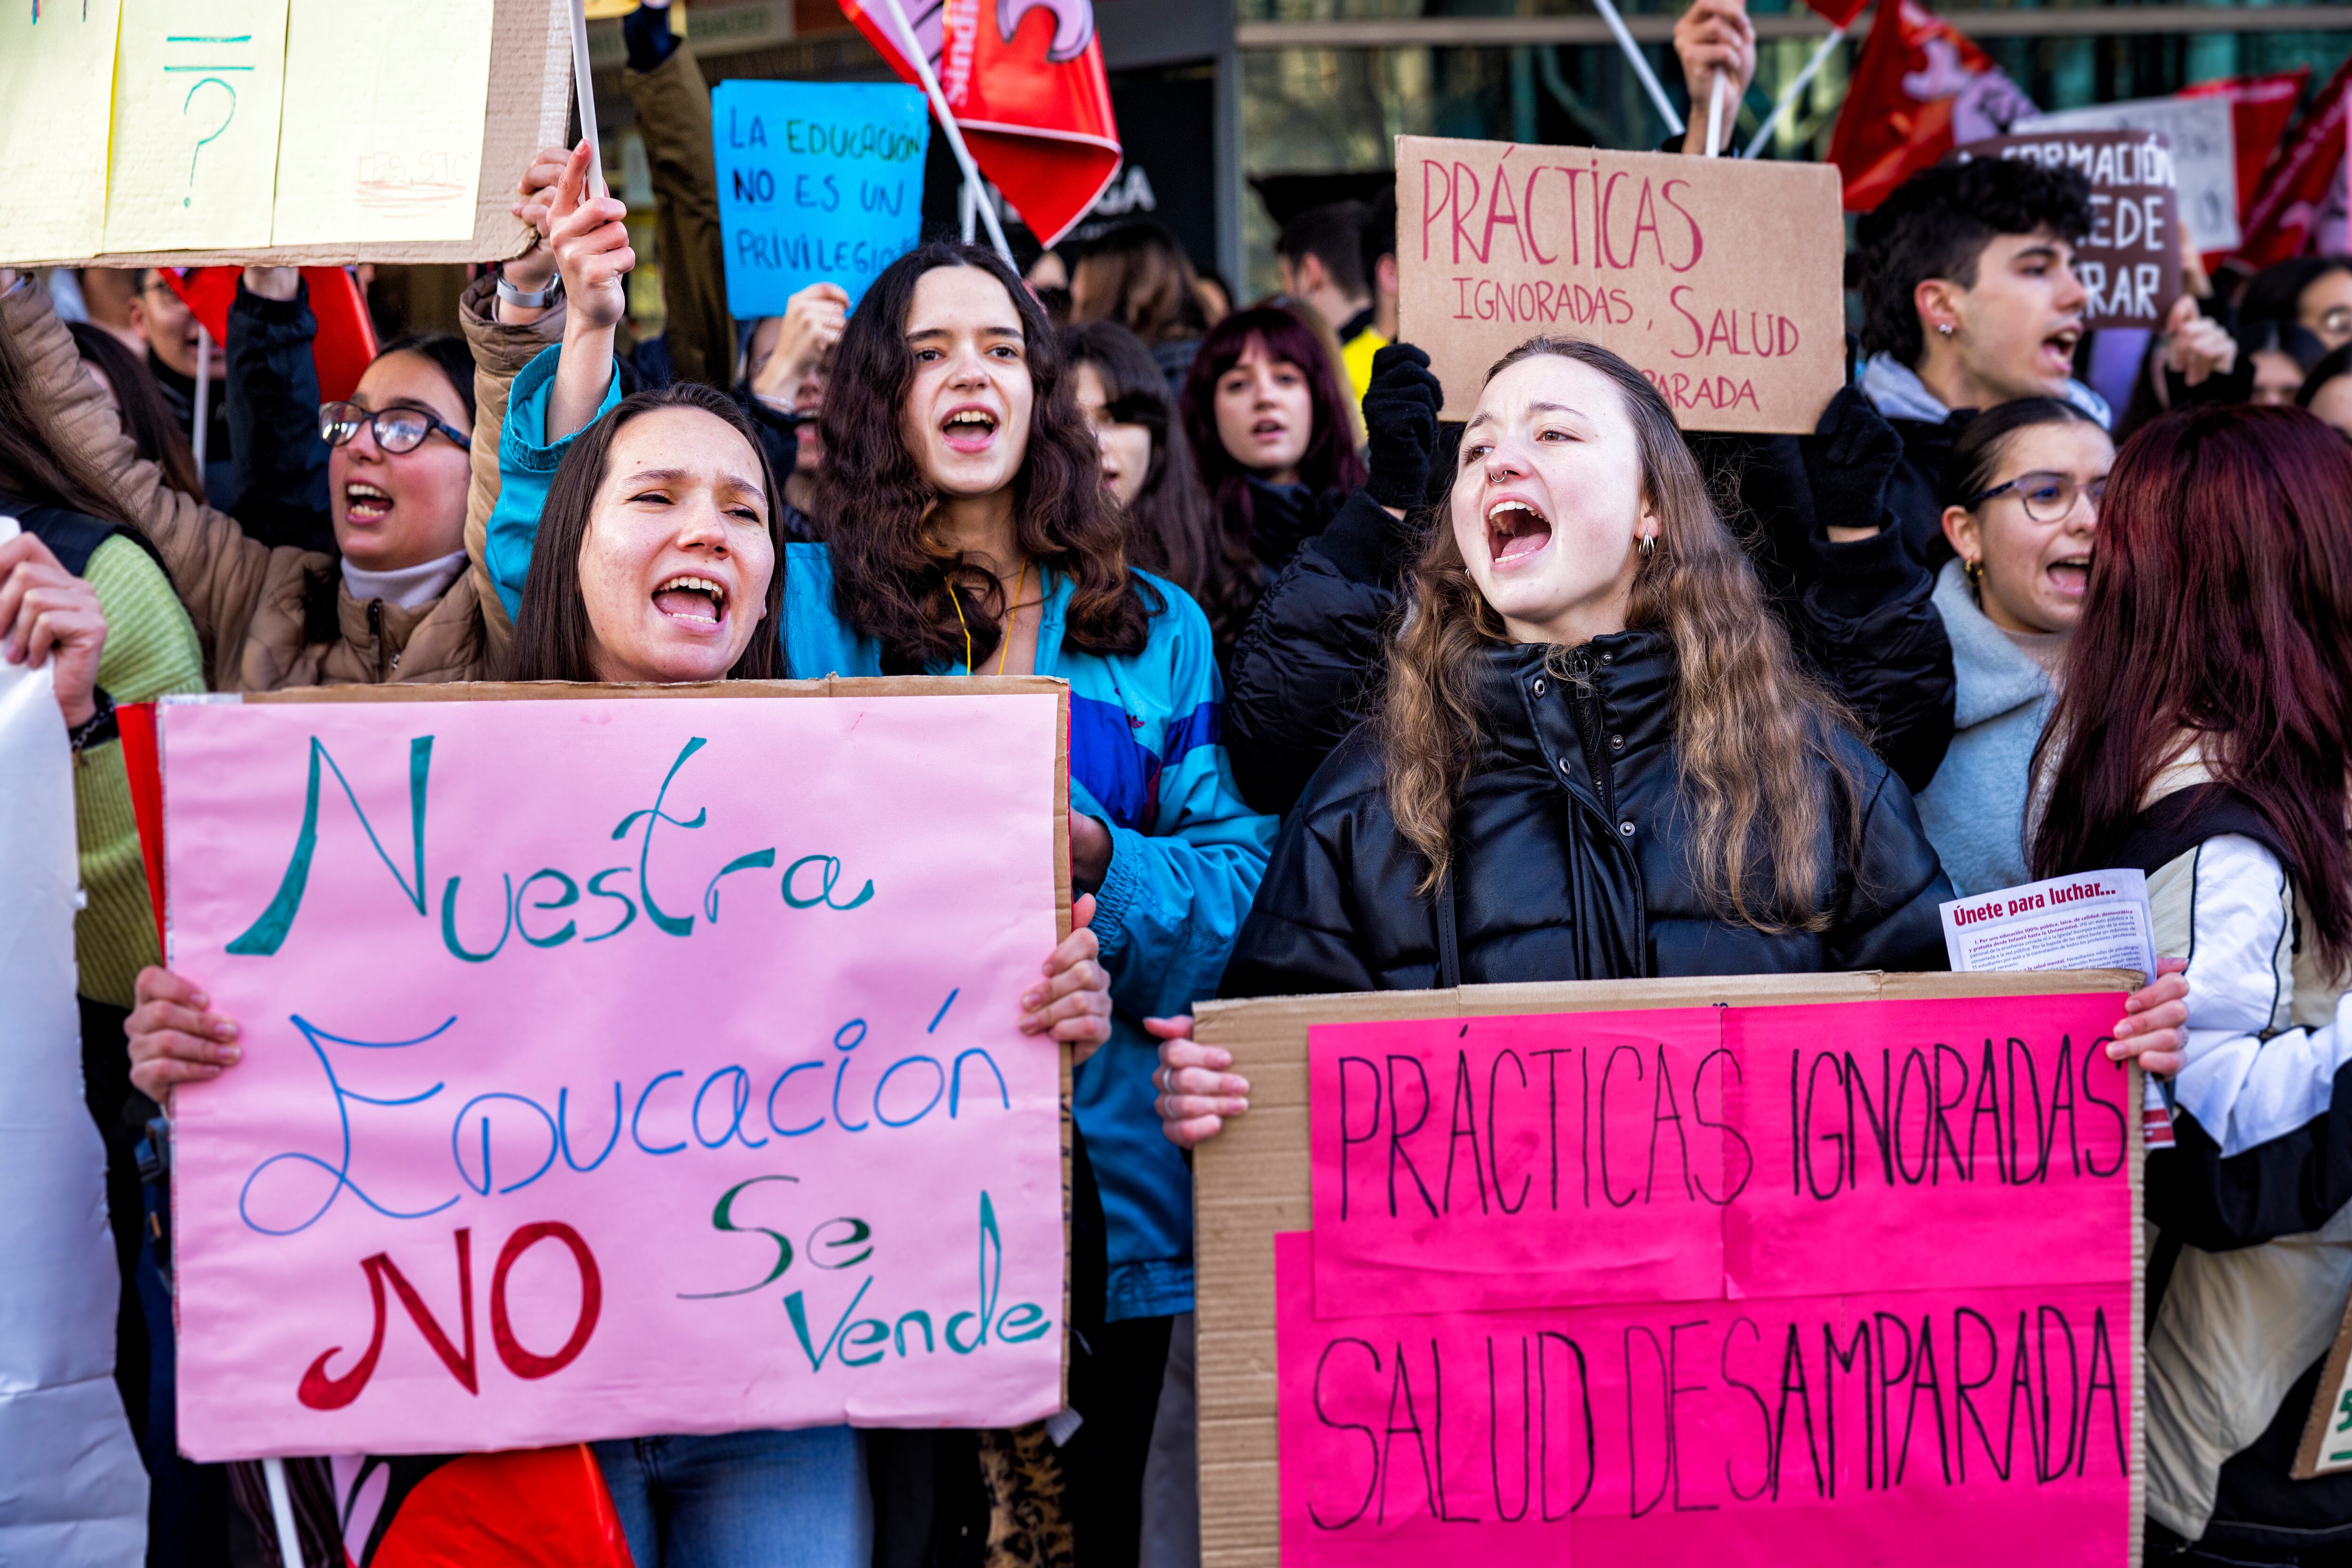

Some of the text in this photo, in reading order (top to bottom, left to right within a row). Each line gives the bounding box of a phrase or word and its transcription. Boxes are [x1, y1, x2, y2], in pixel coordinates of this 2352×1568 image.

[730, 104, 768, 149] LA
[733, 167, 775, 204] NO
[795, 173, 840, 213] ES
[860, 179, 904, 218] UN
[1420, 146, 1703, 273] PRÁCTICAS
[1669, 285, 1799, 358] SALUD
[224, 735, 874, 963] Nuestra
[1954, 882, 2116, 926] Únete para luchar...
[1970, 950, 1988, 958] patronal
[2073, 924, 2105, 934] Incorporación
[1973, 943, 1992, 952] gratuita
[2000, 930, 2024, 939] educación
[2031, 946, 2059, 955] contratación
[2067, 952, 2094, 961] Necesitamos
[1971, 955, 1995, 963] concertada
[1339, 1024, 2128, 1221] PRÁCTICAS IGNORADAS
[296, 1220, 603, 1410] NO
[676, 1175, 874, 1298] Se
[782, 1190, 1051, 1373] Vende
[1308, 1305, 2128, 1530] SALUD DESAMPARADA
